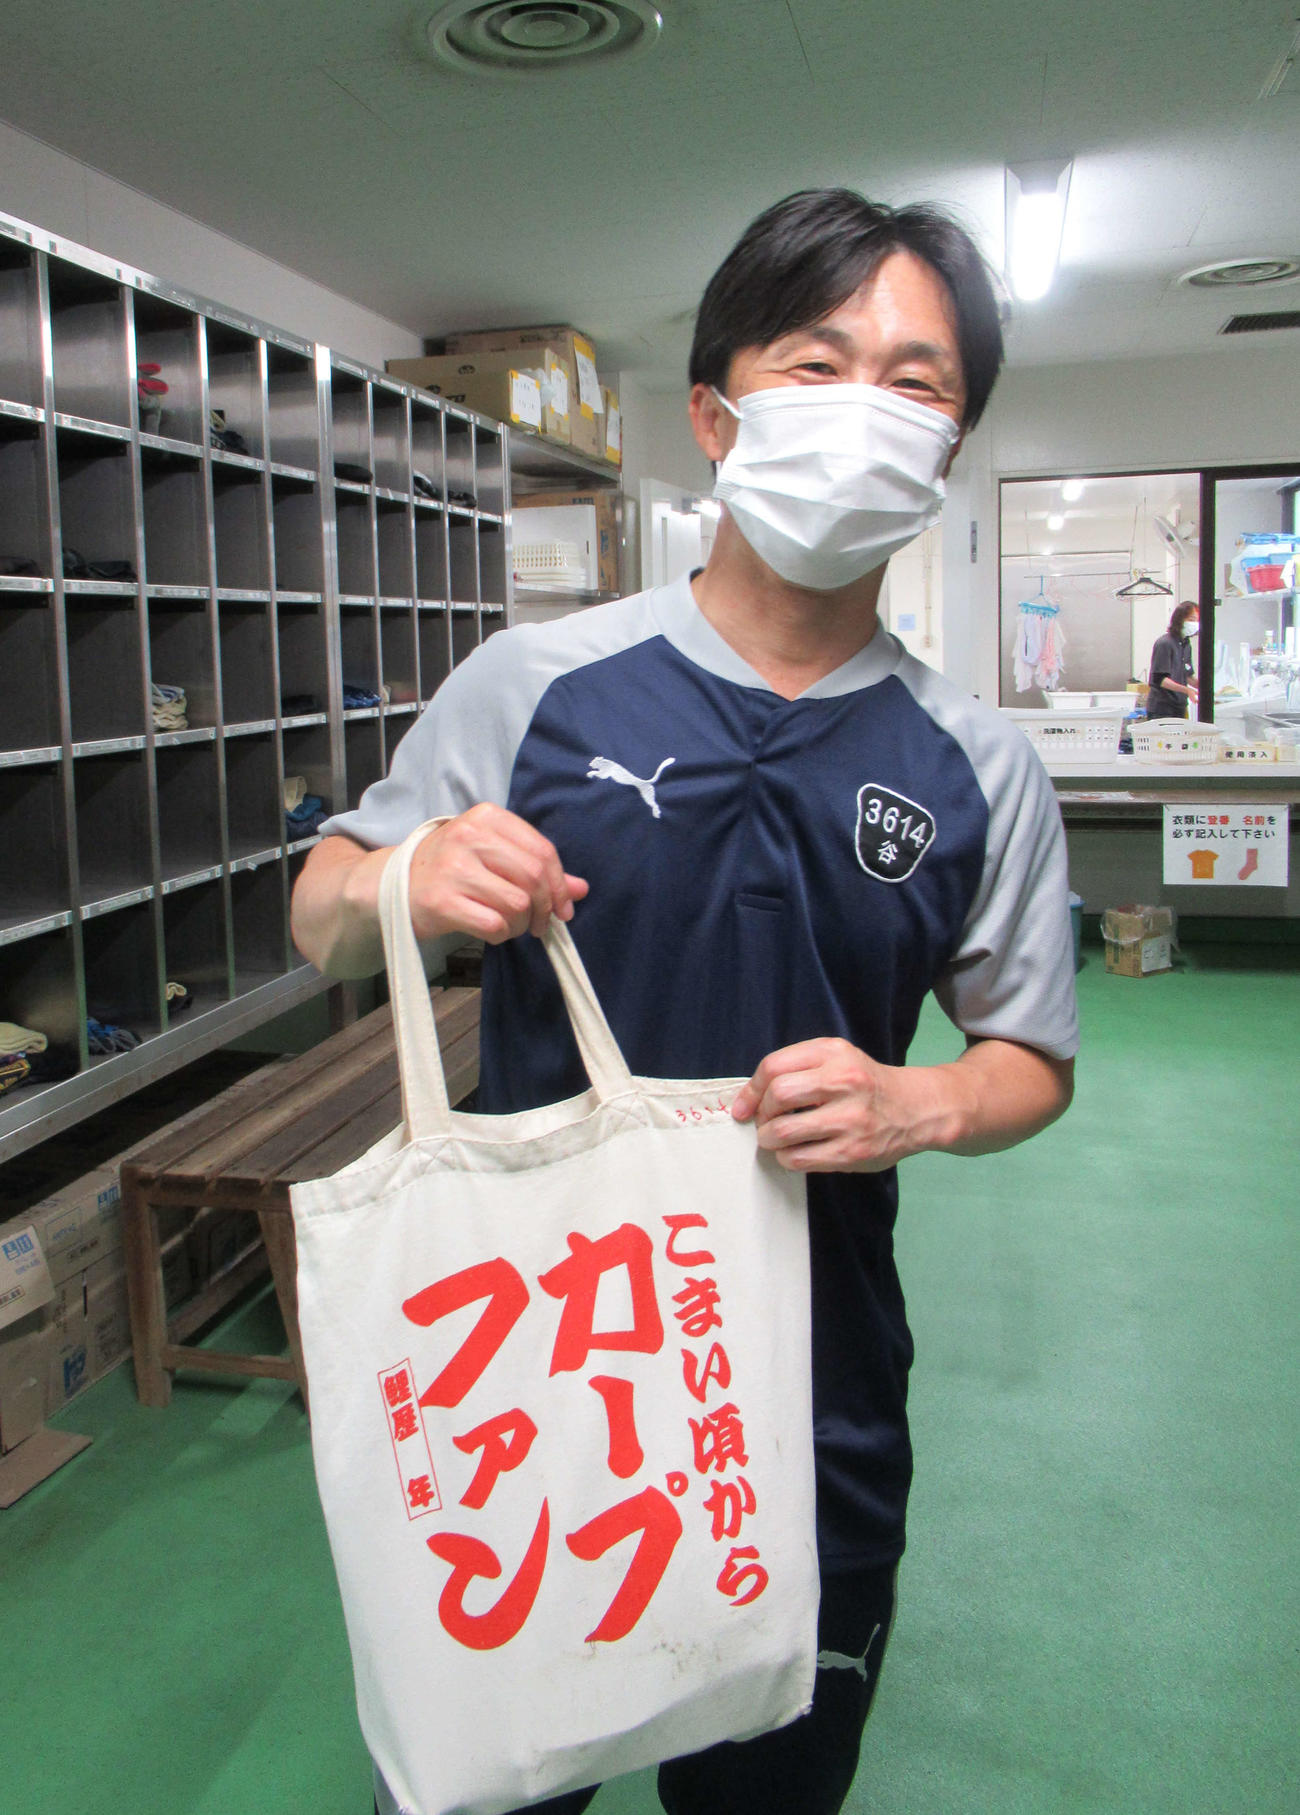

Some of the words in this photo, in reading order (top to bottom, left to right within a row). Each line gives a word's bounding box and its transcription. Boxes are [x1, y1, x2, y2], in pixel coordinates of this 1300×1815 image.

[865, 798, 926, 848] 3614
[877, 840, 898, 865] 谷
[1172, 829, 1275, 839] 必ず記入して下さい
[402, 1257, 550, 1651] ファン
[538, 1223, 689, 1643] カープ
[662, 1213, 769, 1607] こまい頃から
